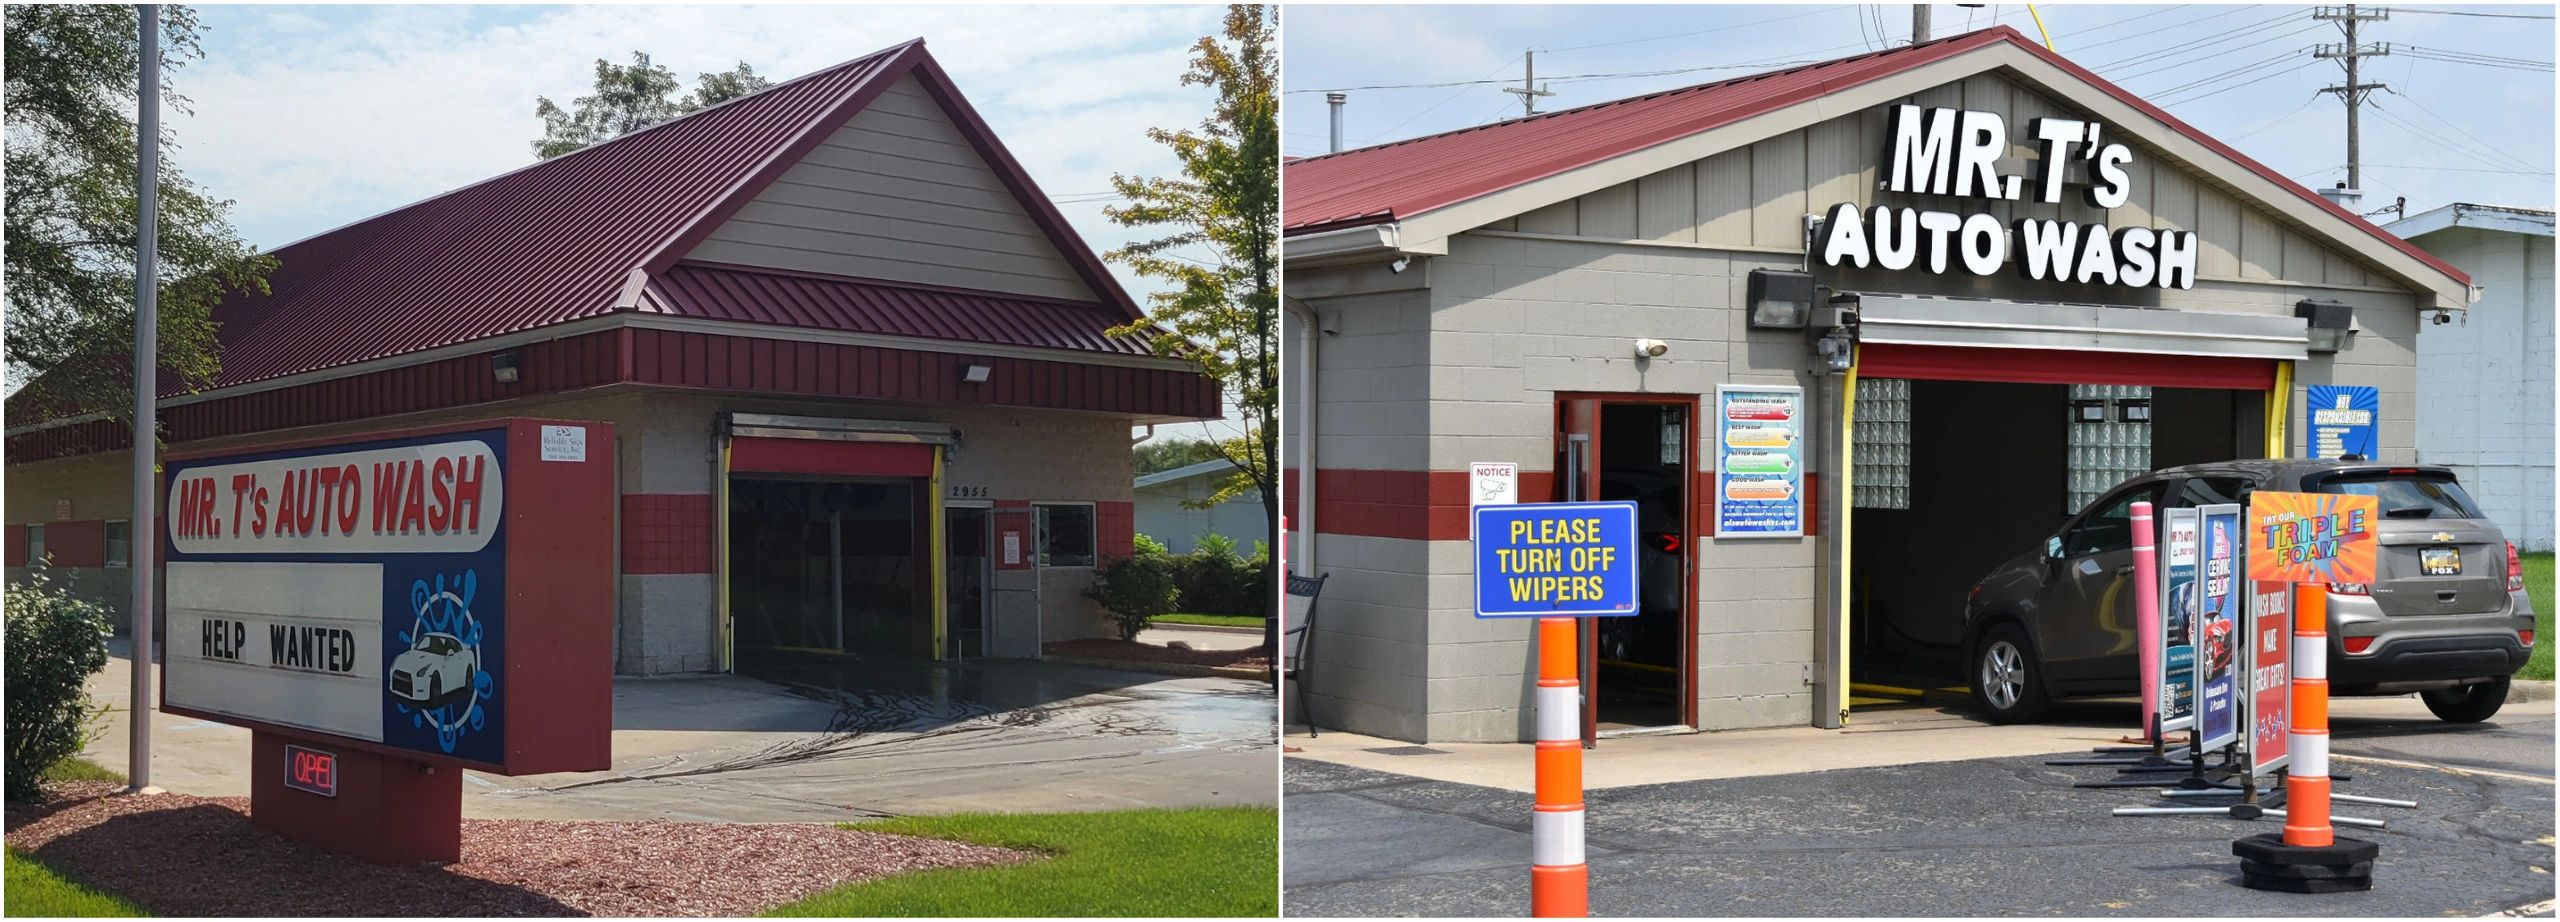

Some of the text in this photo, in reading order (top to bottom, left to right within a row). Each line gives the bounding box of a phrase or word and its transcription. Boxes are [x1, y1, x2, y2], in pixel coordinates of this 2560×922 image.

[1888, 103, 2023, 200] MR.
[1824, 201, 2198, 290] AUTO WASH
[1476, 468, 1511, 477] NOTICE
[177, 477, 221, 539] MR.
[274, 464, 362, 537] AUTO
[372, 454, 485, 535] WASH
[953, 486, 988, 497] 2955
[1510, 518, 1601, 545] PLEASE
[2262, 508, 2365, 549] TRIPLE
[2263, 512, 2295, 525] TRY OUR
[1496, 547, 1616, 574] TURN OFF
[2278, 539, 2338, 568] FOAM
[1509, 575, 1604, 602] WIPERS
[202, 619, 355, 672] HELP WANTED
[2263, 629, 2277, 653] MAKE
